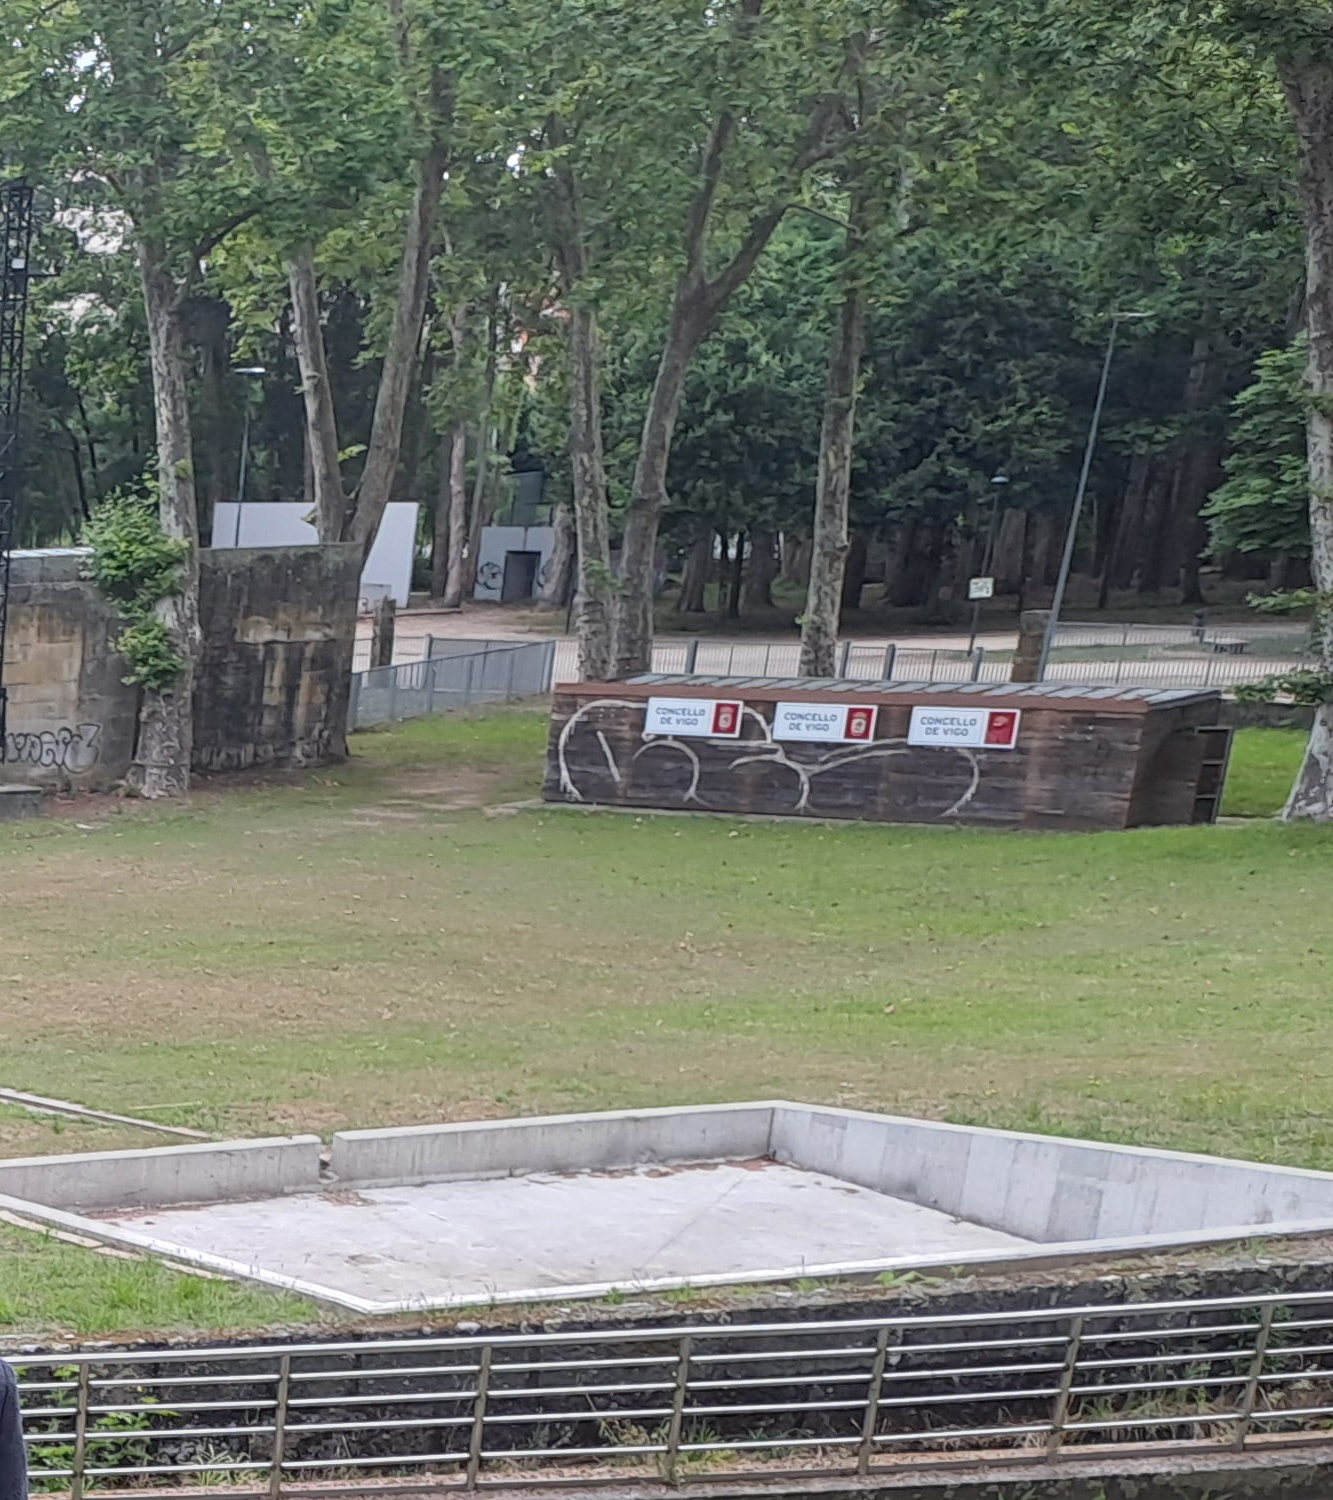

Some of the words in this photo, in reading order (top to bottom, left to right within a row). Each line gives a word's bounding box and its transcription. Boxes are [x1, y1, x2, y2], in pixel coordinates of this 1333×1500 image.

[655, 706, 706, 717] CONCELLO
[660, 717, 672, 725] DE
[675, 718, 699, 726] VIGO
[784, 711, 837, 723] CONCELLO
[920, 716, 977, 726] CONCELLO
[789, 723, 802, 731] DE
[805, 723, 830, 732] VIGO
[925, 727, 939, 736] DE
[942, 728, 969, 737] VIGO
